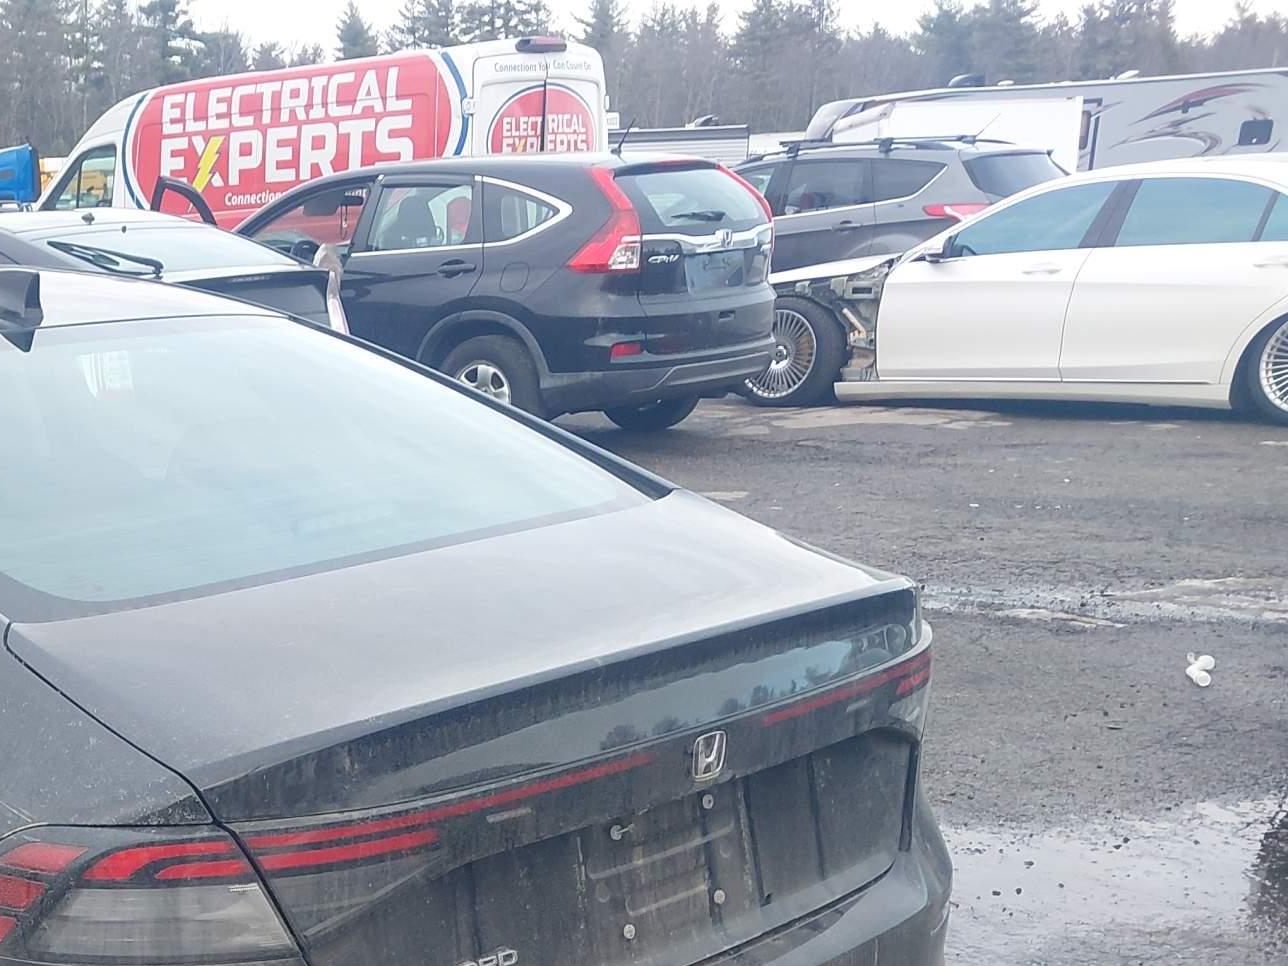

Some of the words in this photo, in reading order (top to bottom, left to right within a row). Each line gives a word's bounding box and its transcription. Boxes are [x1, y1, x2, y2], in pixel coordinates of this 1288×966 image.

[494, 62, 537, 73] Connections
[161, 66, 413, 135] ELECTRICAL
[502, 114, 586, 137] ELECTRICAL
[160, 115, 414, 187] EXPERTS
